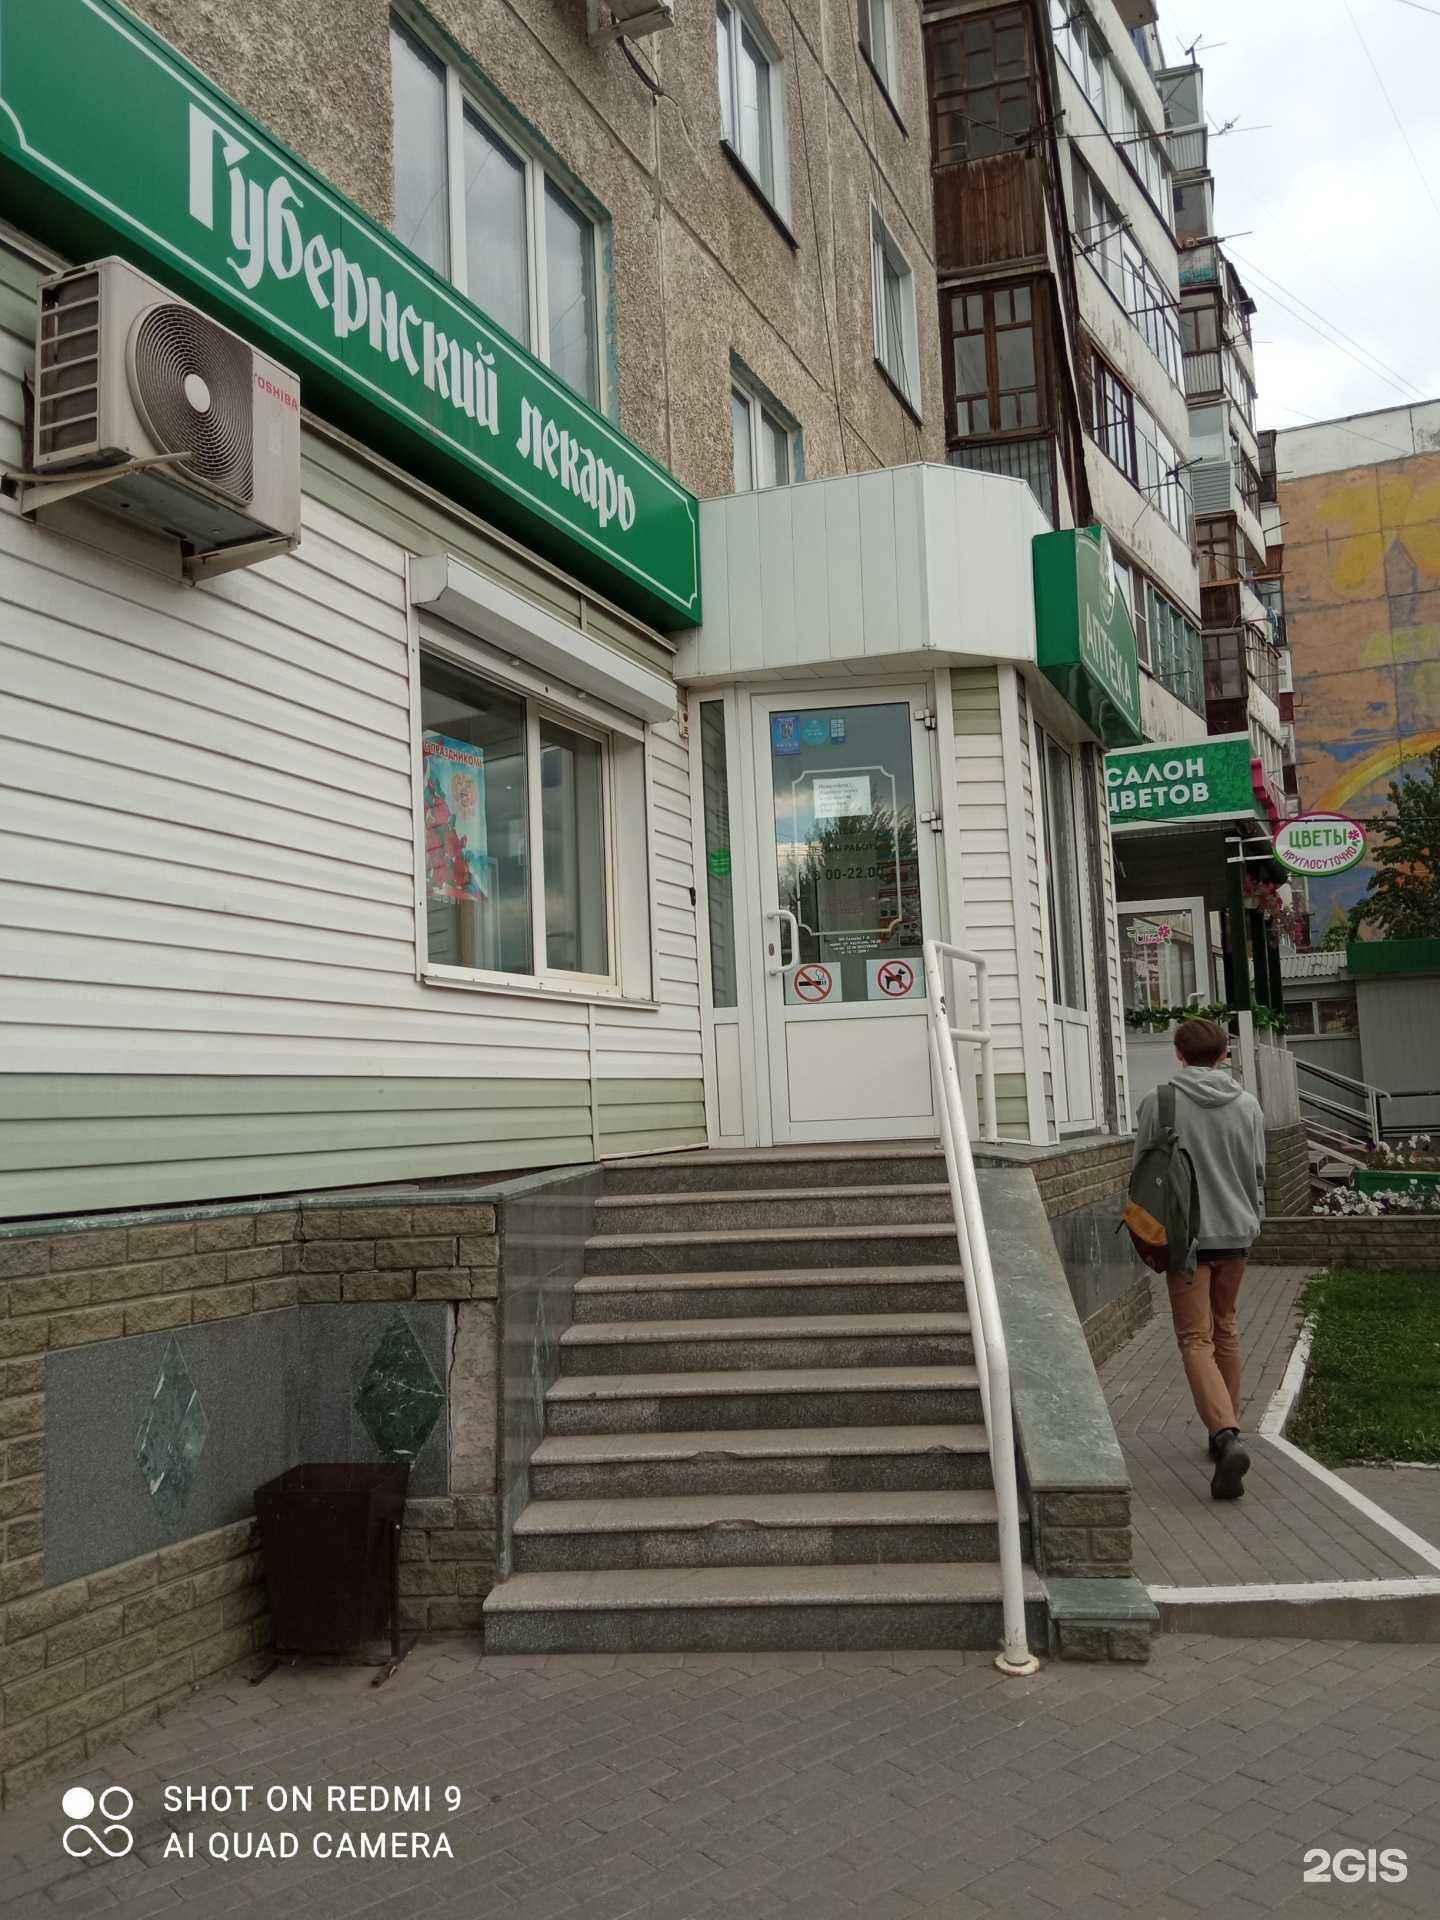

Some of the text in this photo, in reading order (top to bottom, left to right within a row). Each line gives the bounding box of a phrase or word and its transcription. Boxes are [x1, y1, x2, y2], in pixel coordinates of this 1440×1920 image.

[189, 102, 500, 436] Губернский
[1086, 602, 1134, 712] АПТЕКА
[1104, 758, 1204, 787] САЛОН
[1289, 827, 1347, 849] ЦВЕТЫ
[1281, 846, 1357, 870] КРУГЛОСУТОЧНО
